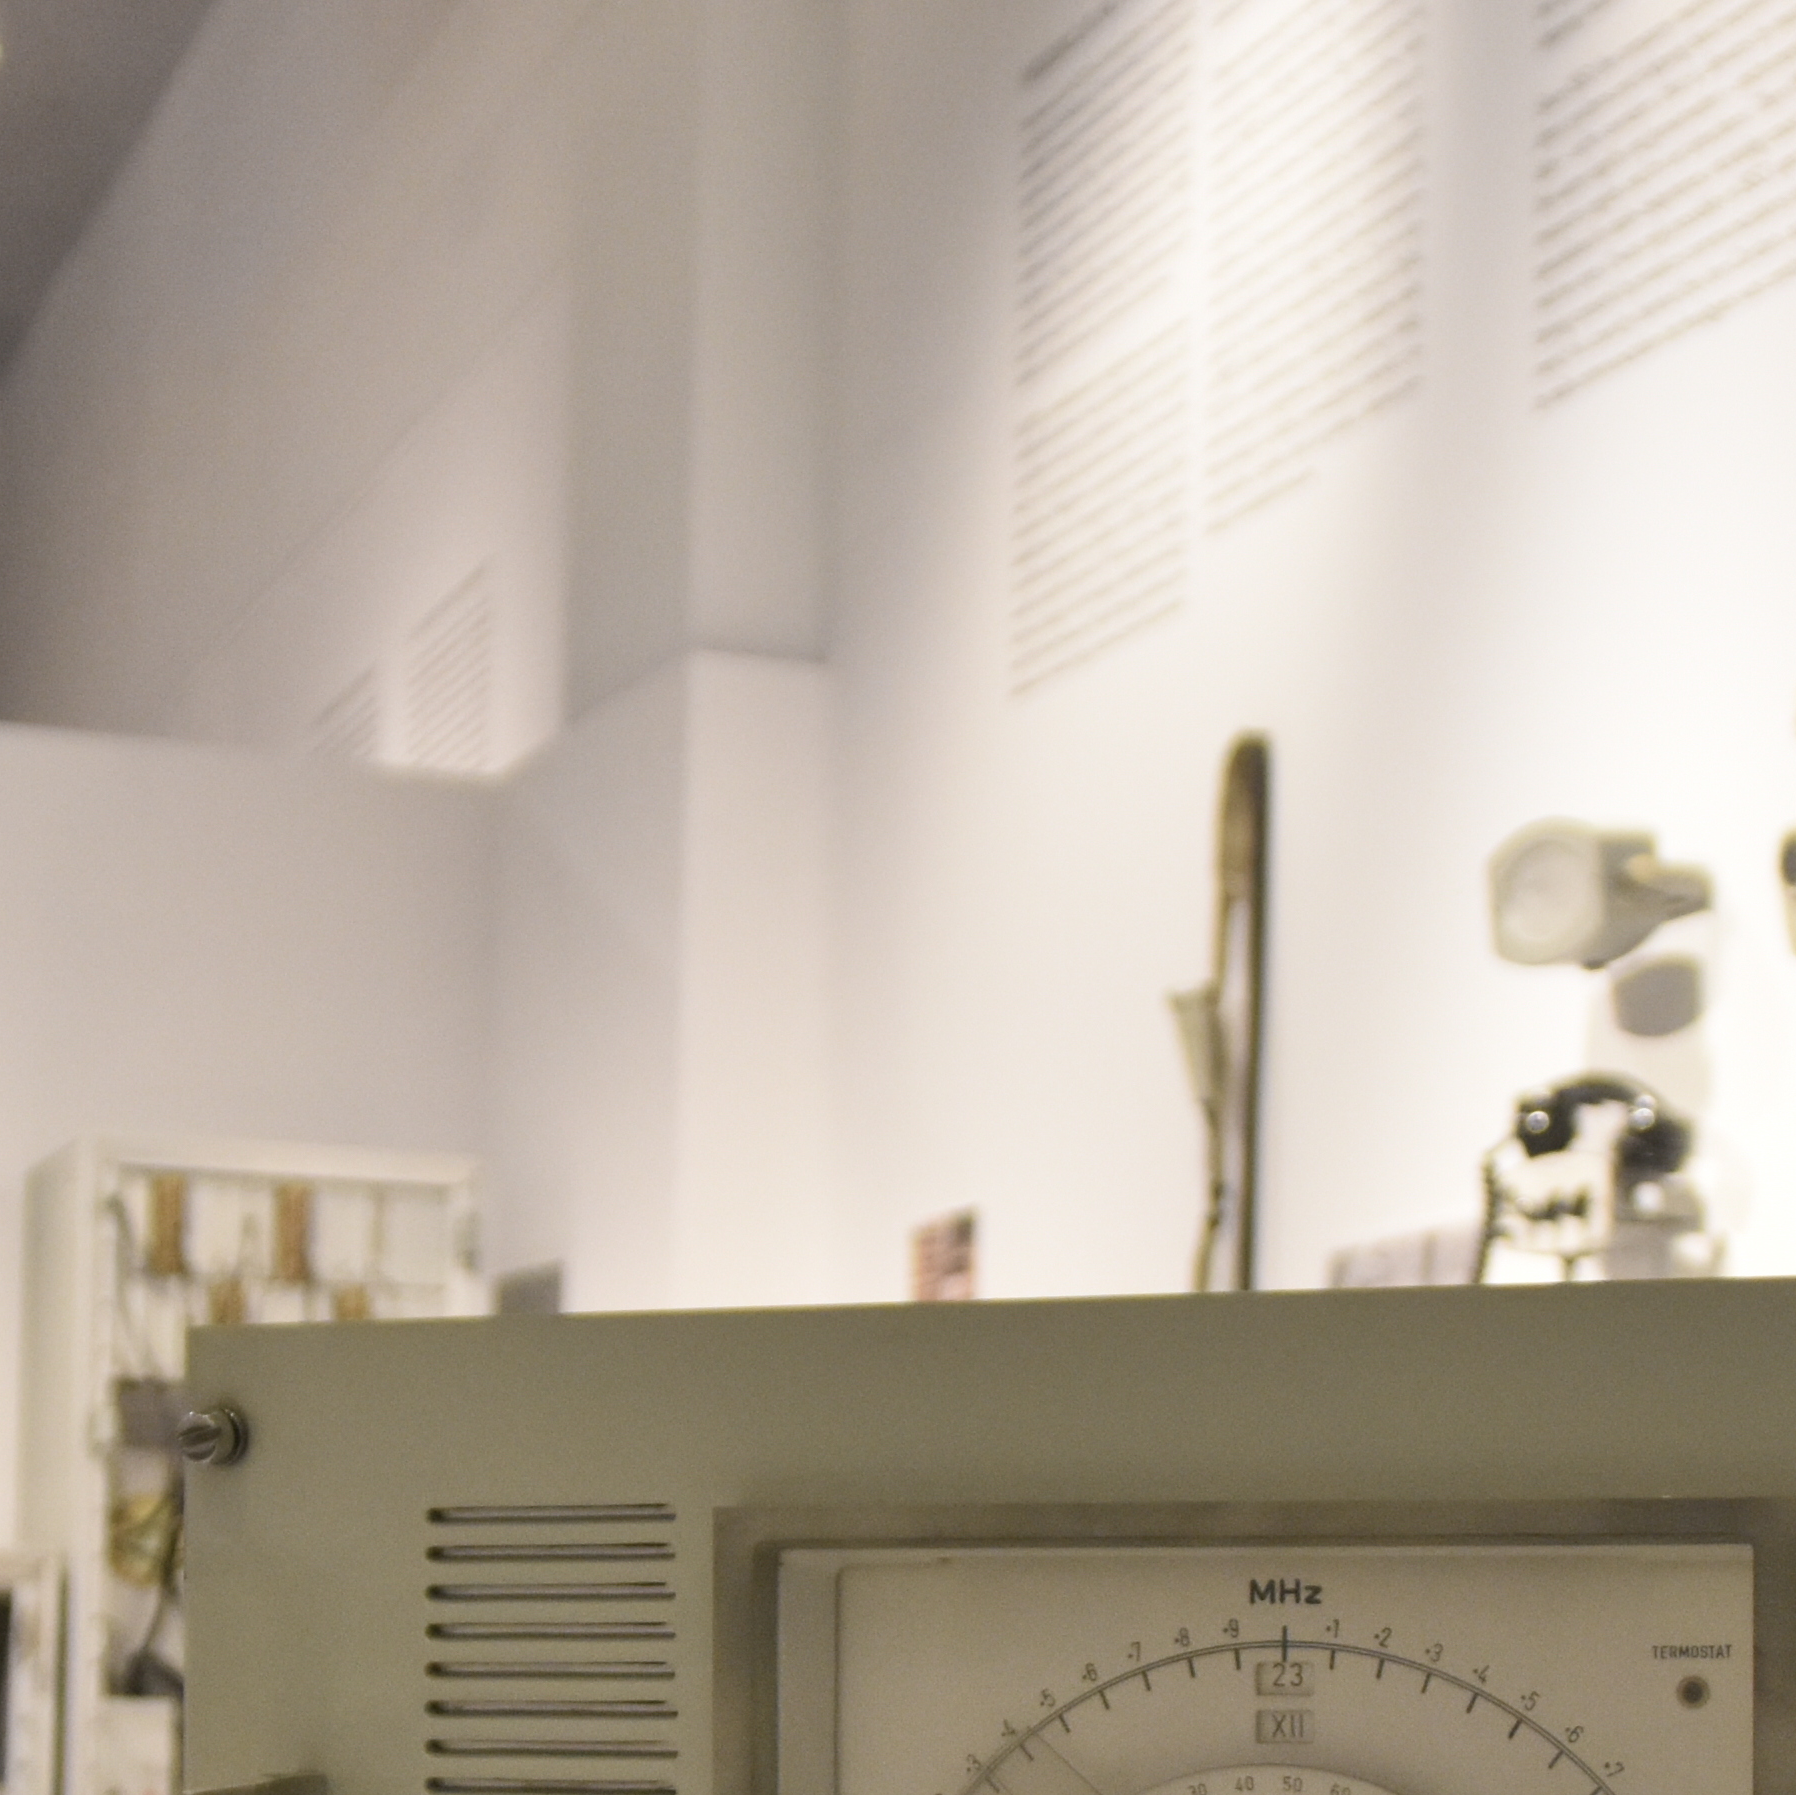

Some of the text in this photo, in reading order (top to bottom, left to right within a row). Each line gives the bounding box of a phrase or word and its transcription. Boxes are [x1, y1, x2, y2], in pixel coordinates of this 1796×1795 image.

[1249, 1579, 1323, 1604] MHz
[1652, 1644, 1733, 1659] TERMOSTAT
[1272, 1663, 1303, 1687] 23
[1272, 1713, 1303, 1738] XII
[1235, 1775, 1254, 1792] 40
[1283, 1776, 1303, 1793] 50
